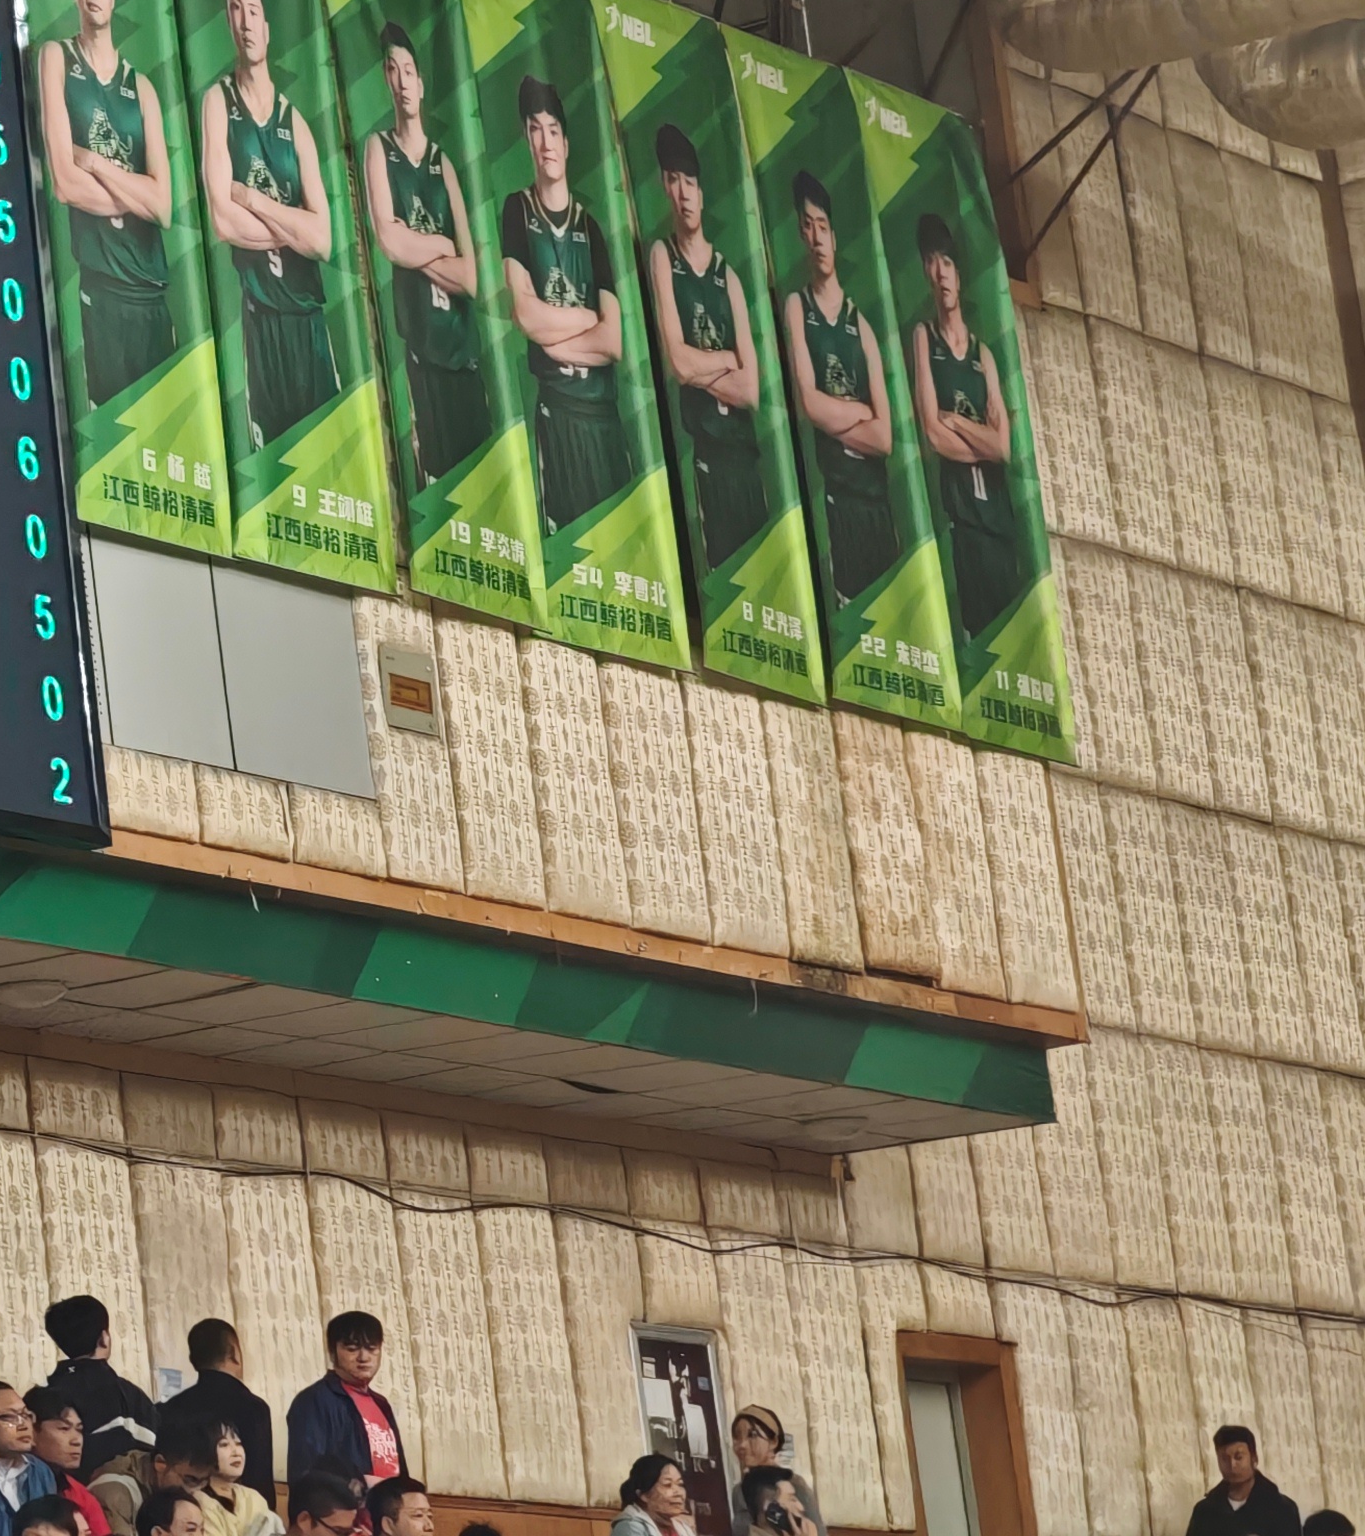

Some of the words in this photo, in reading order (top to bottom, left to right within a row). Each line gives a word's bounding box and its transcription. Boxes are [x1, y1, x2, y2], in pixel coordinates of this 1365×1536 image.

[622, 14, 656, 48] NBL
[756, 63, 788, 96] NBL
[2, 278, 26, 322] 0
[9, 356, 33, 402] 0
[16, 436, 40, 481] 6
[142, 447, 157, 473] 6
[102, 473, 215, 528] 江西鲸裕清酒
[292, 484, 307, 508] 9
[25, 513, 48, 561] 0
[266, 511, 379, 564] 江西鲸裕清酒
[449, 519, 471, 545] 19
[572, 563, 604, 590] 54
[614, 571, 667, 608] 李曹北
[34, 593, 56, 641] 5
[860, 634, 887, 658] 22
[41, 675, 65, 722] 0
[995, 670, 1009, 691] 11
[50, 757, 74, 806] 2
